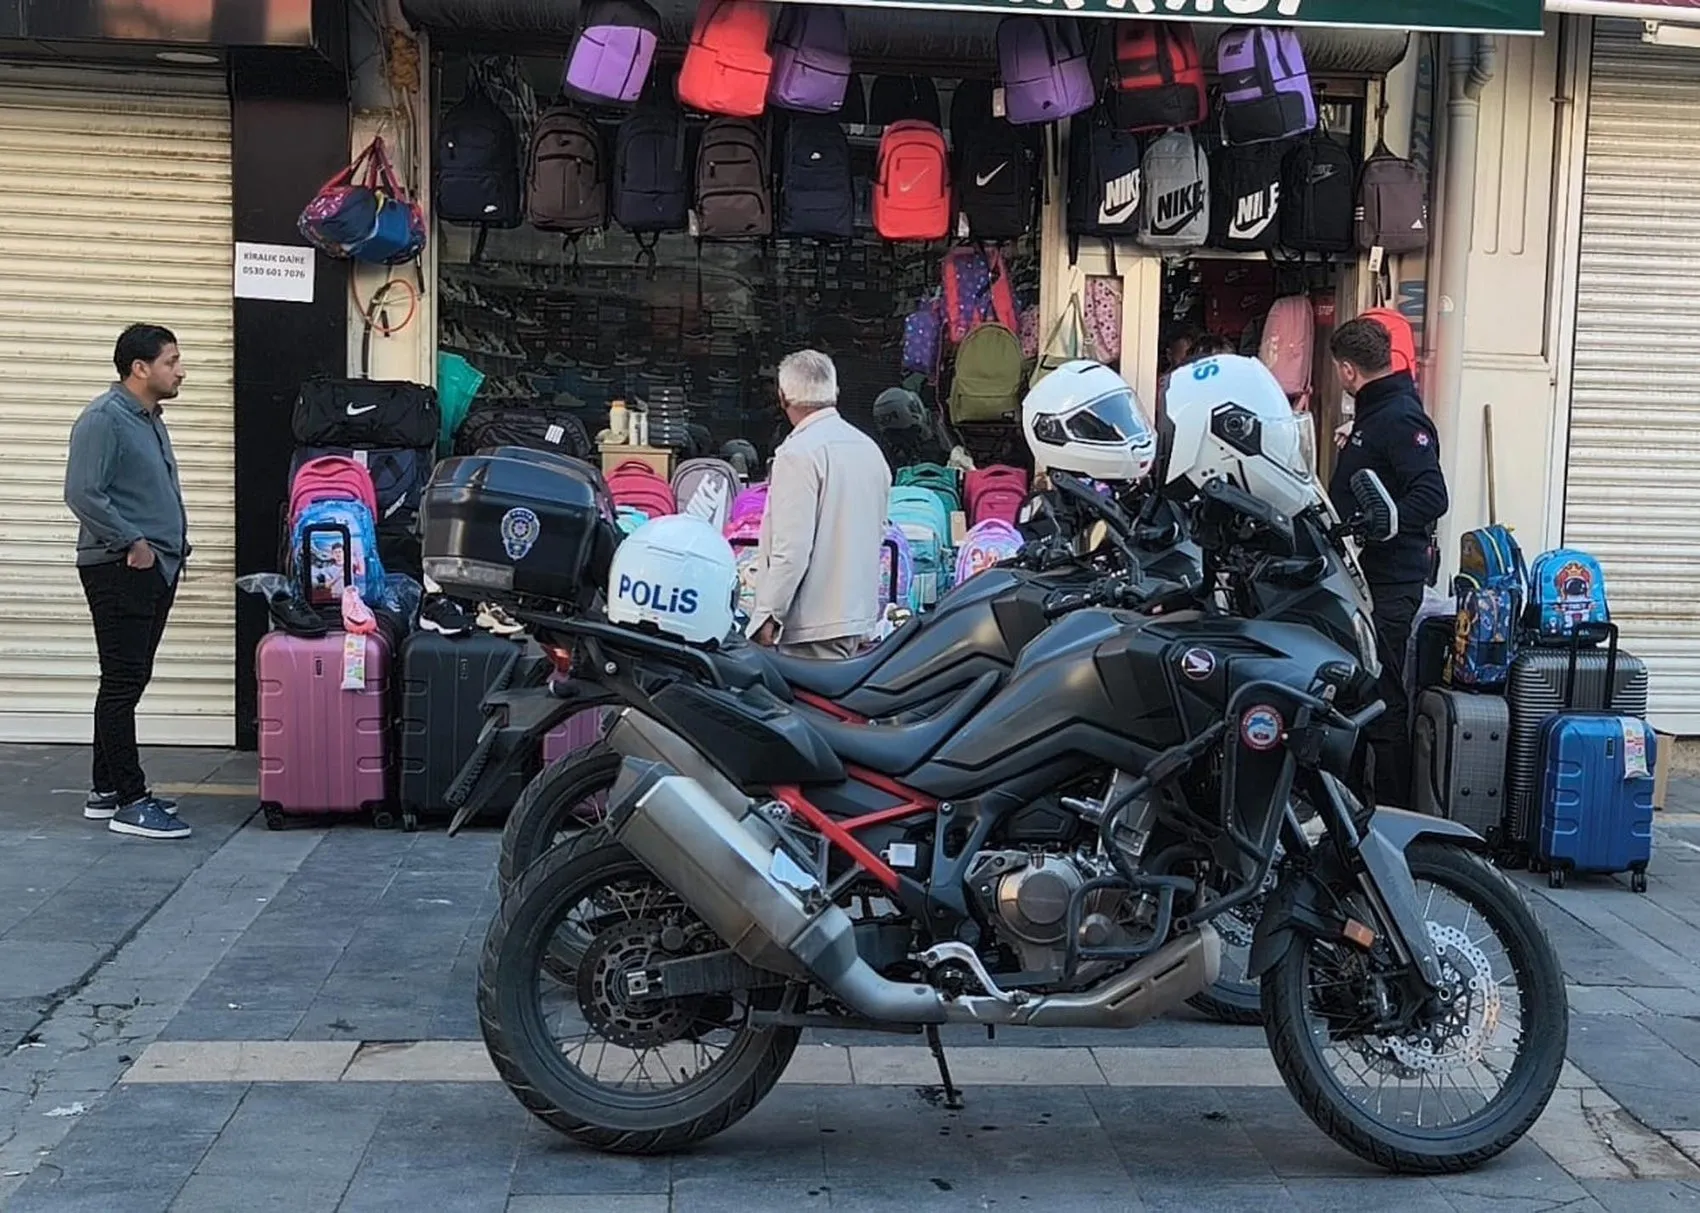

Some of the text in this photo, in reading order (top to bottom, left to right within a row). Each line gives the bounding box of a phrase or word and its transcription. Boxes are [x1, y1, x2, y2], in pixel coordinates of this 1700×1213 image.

[1157, 180, 1204, 223] NIKE
[242, 266, 265, 276] 0530
[266, 268, 282, 277] 601
